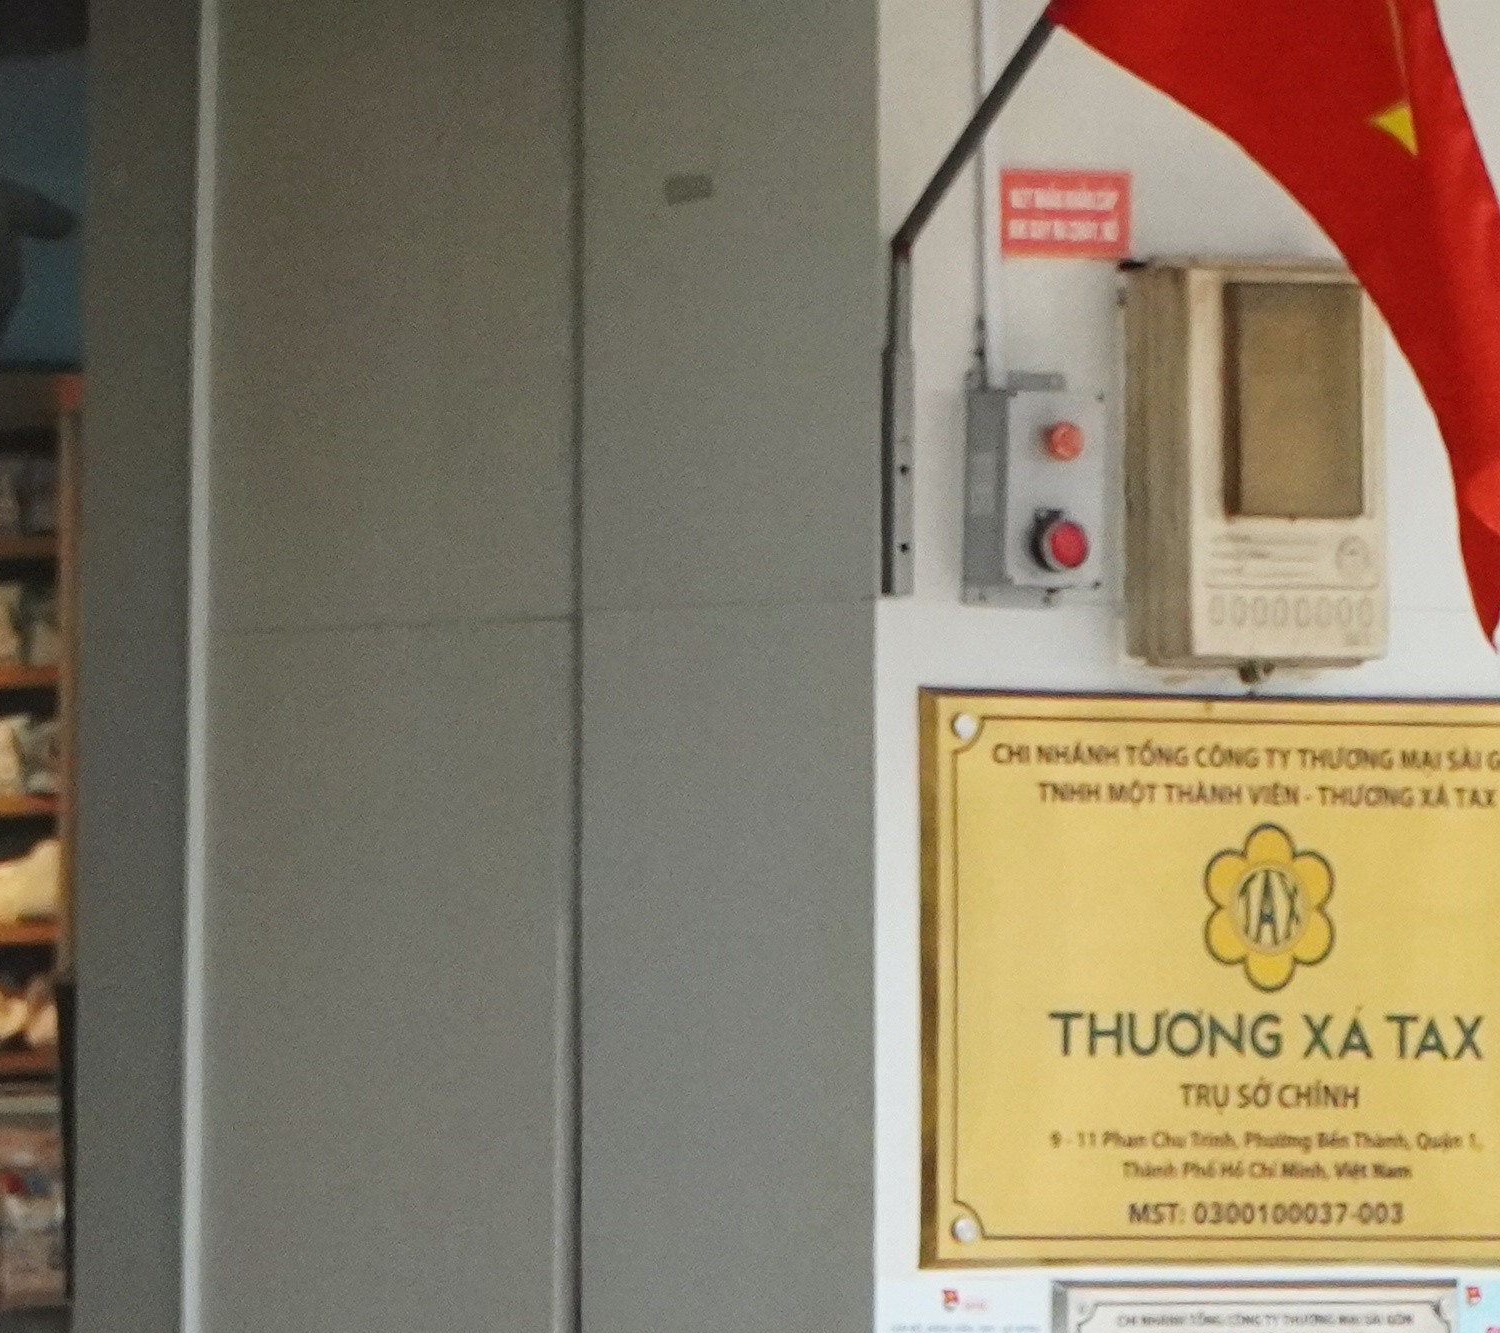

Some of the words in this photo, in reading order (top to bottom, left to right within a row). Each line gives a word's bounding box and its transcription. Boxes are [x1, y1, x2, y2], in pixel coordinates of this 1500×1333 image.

[1265, 747, 1291, 770] TY
[1049, 1008, 1283, 1059] THƯƠNG
[1383, 1013, 1486, 1061] TAX
[1180, 1083, 1231, 1116] TRỤ
[1276, 1077, 1360, 1110] CHÍNH
